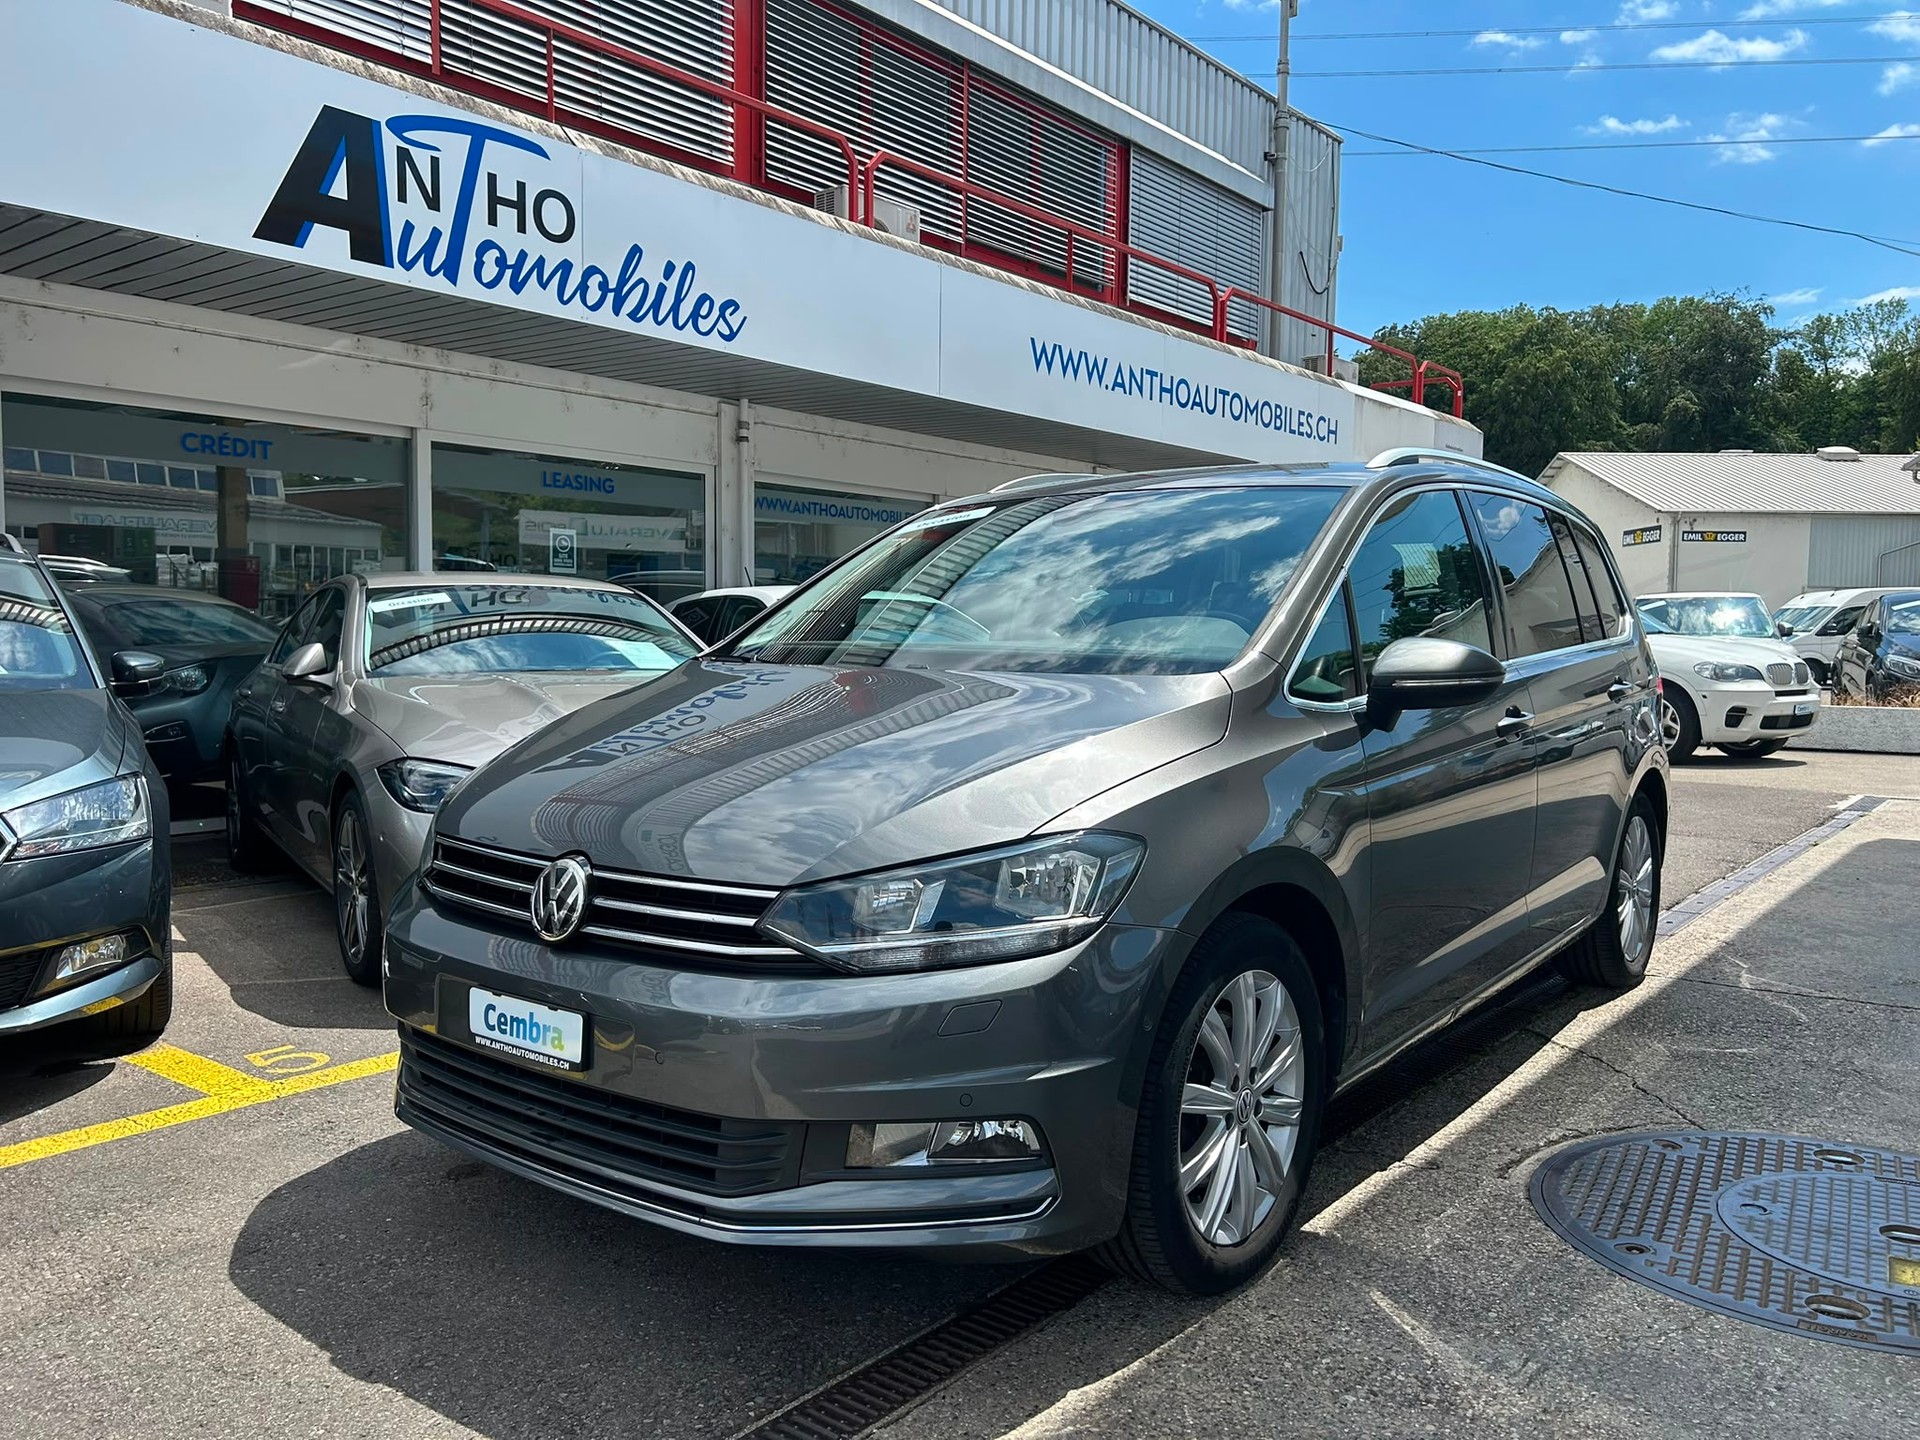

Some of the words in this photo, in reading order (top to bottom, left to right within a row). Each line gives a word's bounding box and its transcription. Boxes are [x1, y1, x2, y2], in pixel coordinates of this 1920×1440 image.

[252, 103, 576, 286] ANTHO
[1029, 336, 1339, 445] WWW.ANTHOAUTOMOBILES.CH
[179, 431, 272, 460] CRÉDIT
[541, 470, 615, 494] LEASING
[755, 496, 916, 524] WWW.ANTHOAUTOMOBILE
[1623, 533, 1635, 546] EMIL
[1642, 529, 1660, 543] EGGER
[1683, 533, 1703, 541] EMIL
[1716, 533, 1746, 542] EGGER
[483, 1003, 565, 1051] Cembra
[243, 1044, 331, 1074] 5
[475, 1035, 570, 1071] WWW.ANTHOAUTOMOBILES.CH
